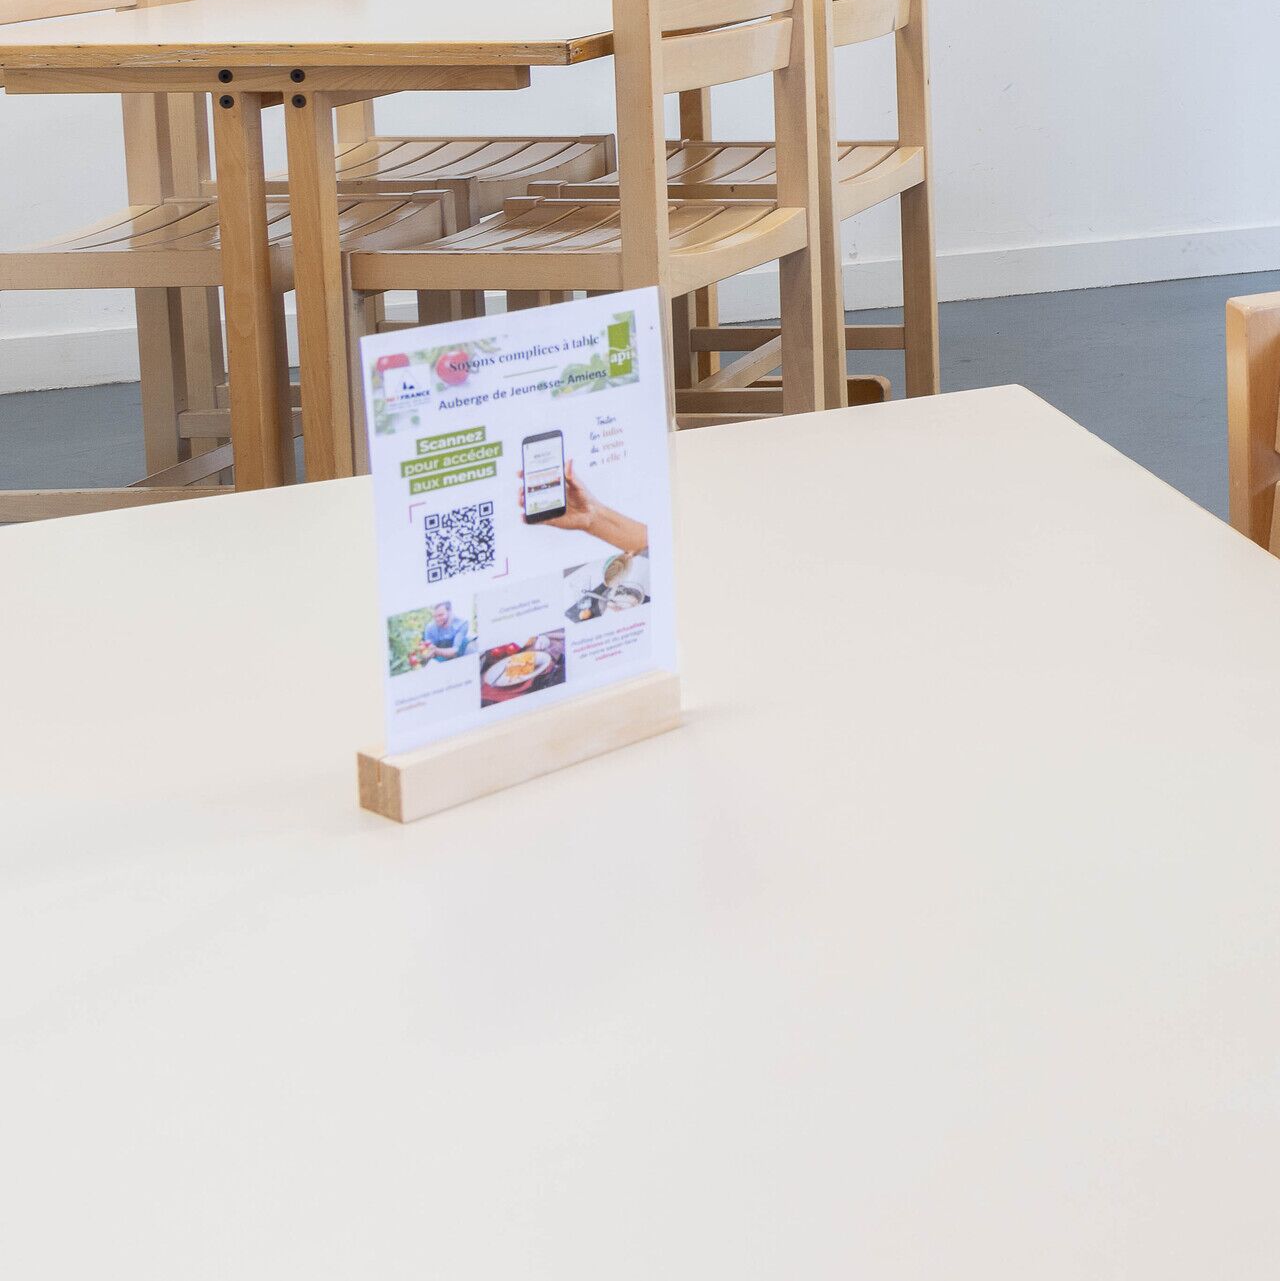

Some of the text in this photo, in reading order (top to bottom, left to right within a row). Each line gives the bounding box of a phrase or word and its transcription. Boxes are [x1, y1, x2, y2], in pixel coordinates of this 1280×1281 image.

[449, 334, 600, 373] Soyons complices à table
[610, 345, 633, 366] api
[438, 394, 489, 411] Auberge
[492, 389, 507, 400] de
[567, 369, 607, 385] Amiens
[420, 431, 483, 453] Scannez
[404, 445, 500, 478] pour accéder
[413, 466, 494, 493] aux menus
